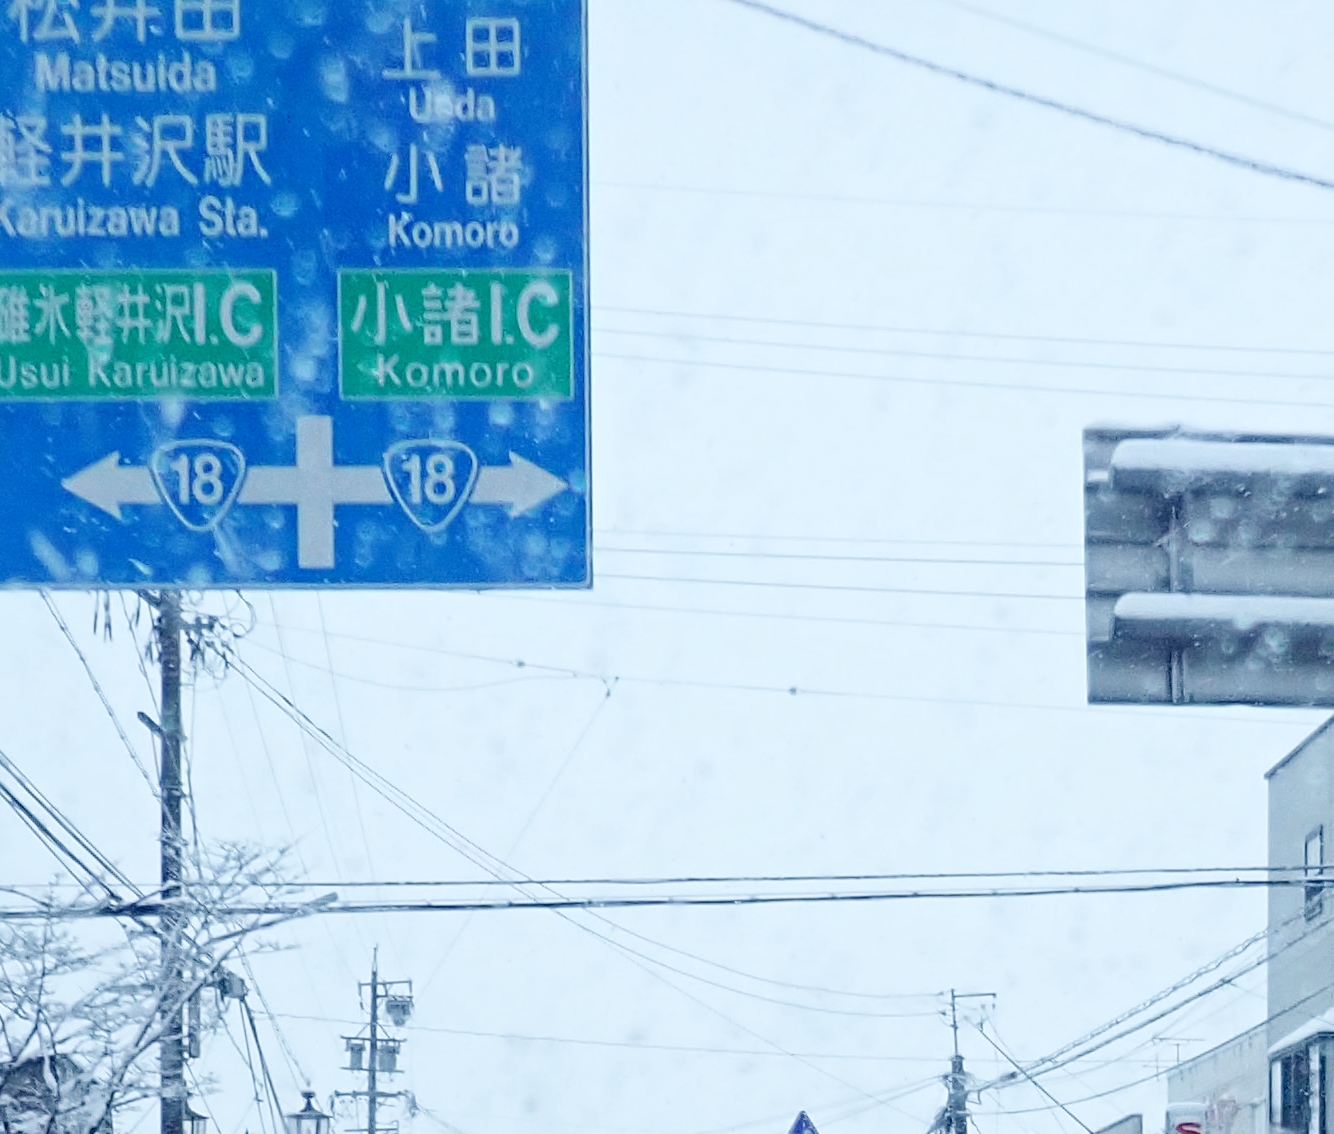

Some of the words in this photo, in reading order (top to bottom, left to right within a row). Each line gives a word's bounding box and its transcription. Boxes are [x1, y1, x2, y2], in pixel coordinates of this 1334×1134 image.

[382, 18, 519, 79] 上田
[33, 51, 216, 94] Matsuida
[384, 143, 521, 205] 小諸
[199, 195, 268, 237] Sta.
[388, 212, 519, 249] Komoro
[350, 279, 560, 349] 小諸I.C
[88, 353, 265, 388] Karuizawa
[376, 352, 534, 388] Komoro
[170, 453, 224, 505] 18
[402, 453, 456, 505] 18
